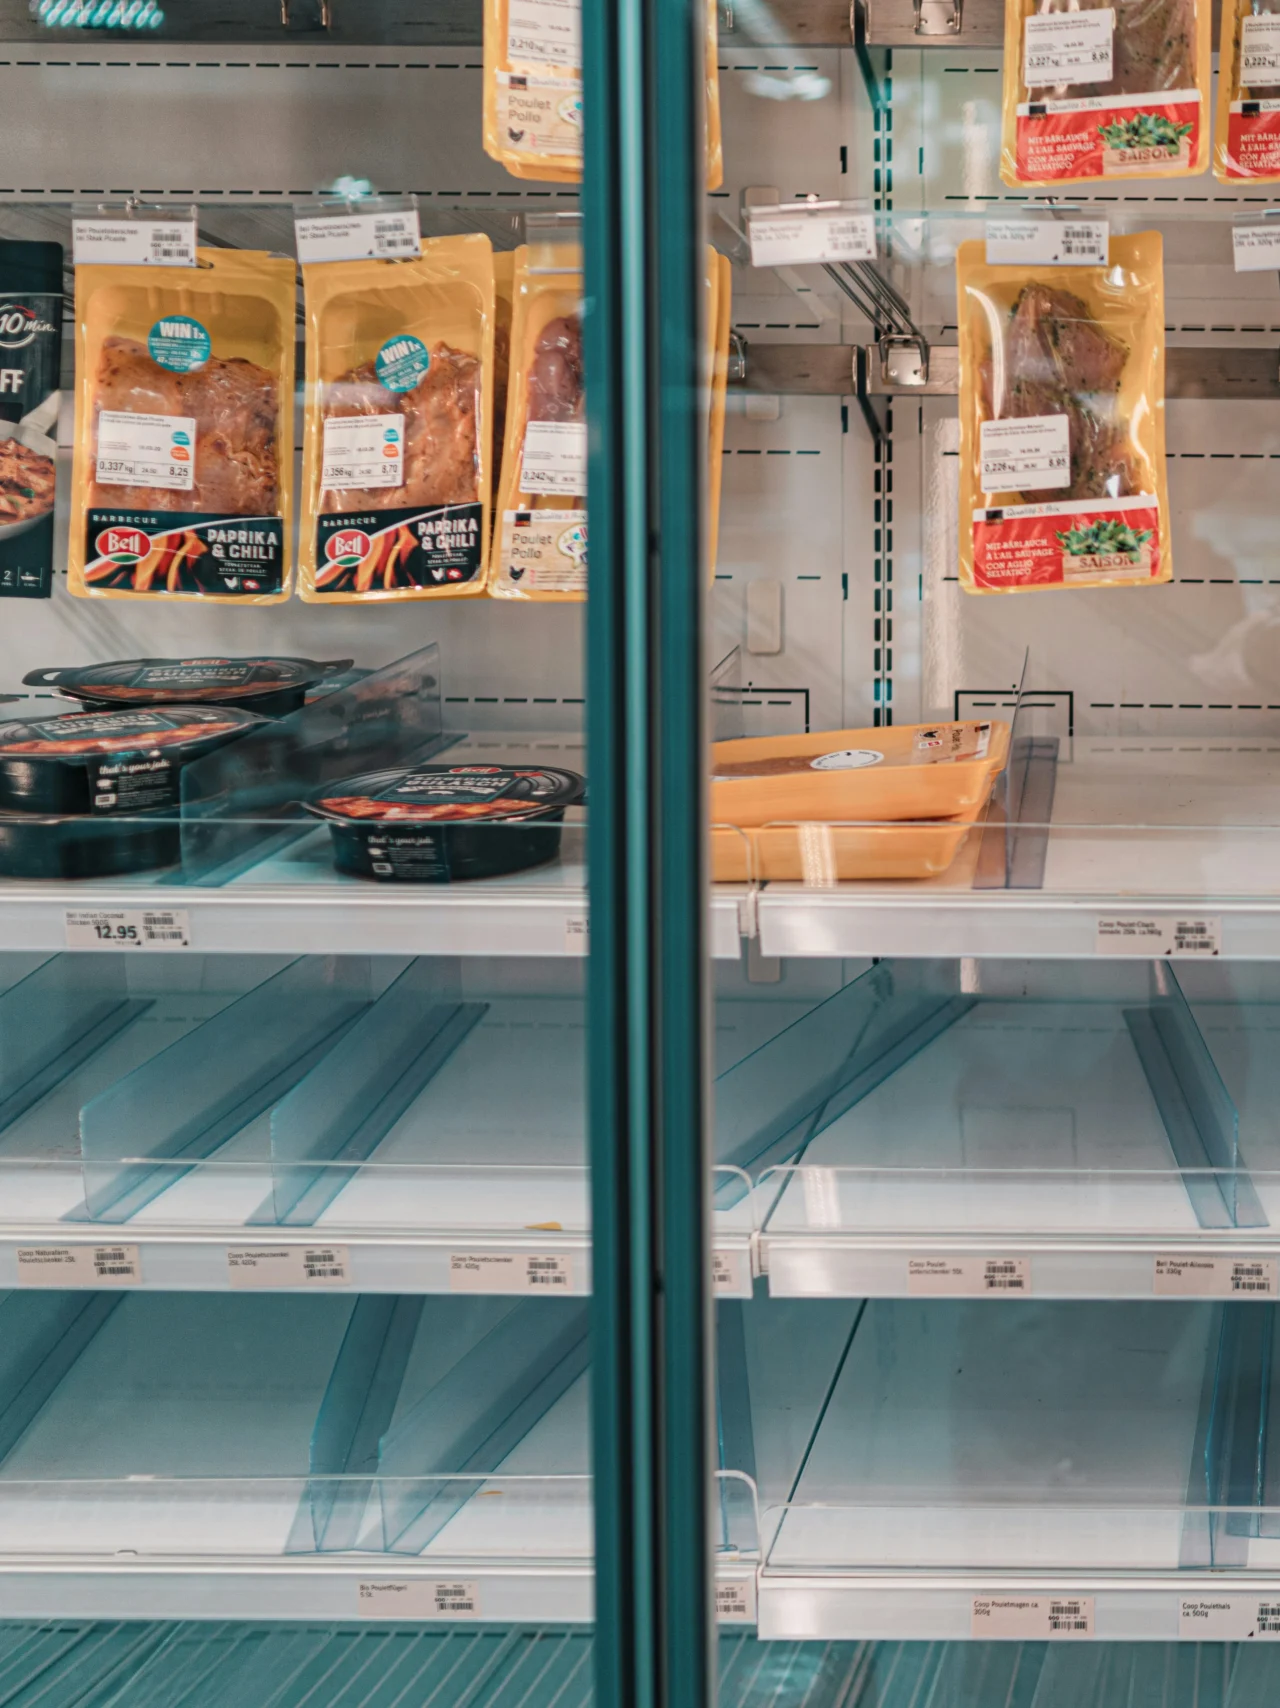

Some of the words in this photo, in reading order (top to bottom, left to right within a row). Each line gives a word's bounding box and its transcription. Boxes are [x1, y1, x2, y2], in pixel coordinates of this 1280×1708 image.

[508, 95, 551, 110] Poulet
[508, 110, 541, 123] Pollo
[1240, 134, 1256, 143] MIT
[1119, 148, 1174, 162] SAISON
[159, 321, 192, 339] WIN
[380, 341, 408, 364] WIN
[99, 460, 124, 471] 0,337
[169, 466, 189, 477] 8,25
[381, 463, 398, 476] 8,70
[93, 513, 158, 524] BARBECUE
[322, 516, 377, 528] BARBECUE
[417, 517, 479, 536] PAPRIKA
[108, 532, 140, 553] Bell
[207, 529, 279, 545] PAPRIKA
[421, 536, 434, 550] &
[435, 533, 476, 551] CHILI
[511, 533, 553, 545] Poulet
[211, 543, 226, 558] &
[229, 544, 275, 560] CHILI
[335, 536, 362, 554] Bell
[510, 547, 542, 559] Pollo
[986, 561, 1004, 571] CON
[1007, 560, 1034, 569] AGLIO
[1079, 555, 1135, 569] SAISON
[4, 570, 11, 580] 2
[95, 925, 137, 939] 12.95
[1182, 1602, 1199, 1610] Coop
[1192, 1610, 1209, 1618] 500g
